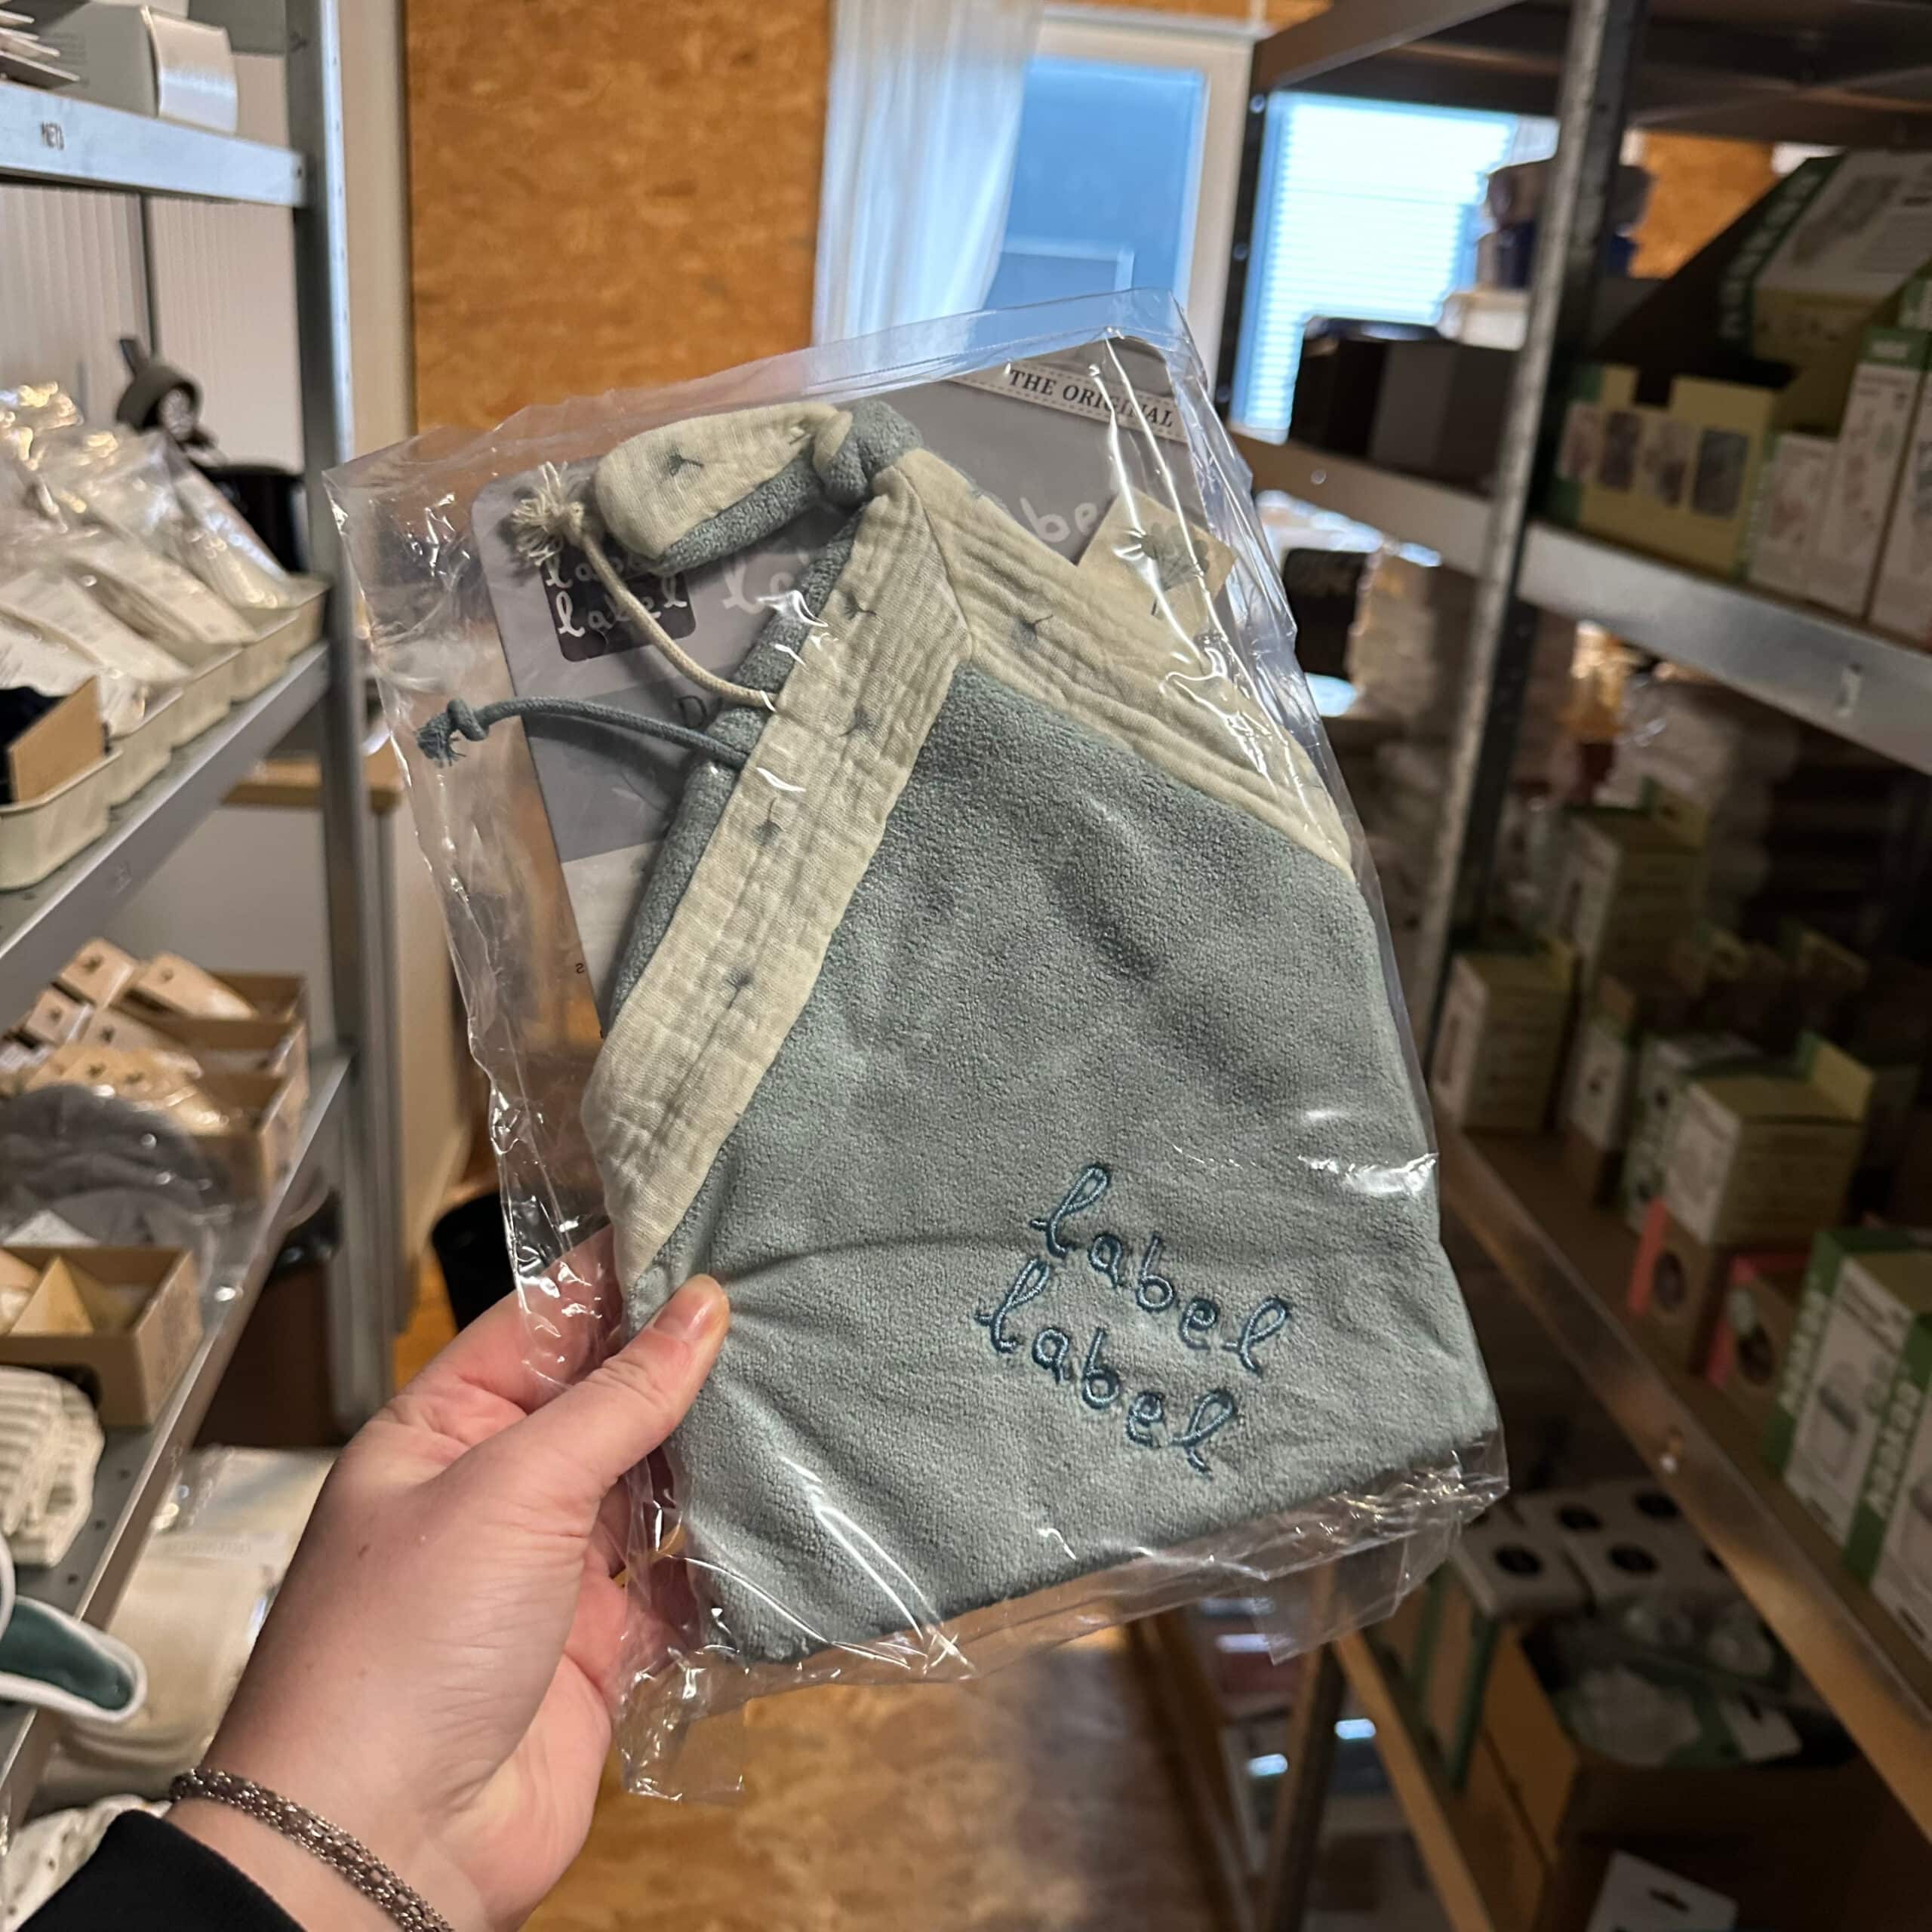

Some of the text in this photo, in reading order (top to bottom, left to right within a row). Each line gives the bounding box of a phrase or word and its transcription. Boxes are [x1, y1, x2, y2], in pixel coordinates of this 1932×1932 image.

[1009, 369, 1174, 428] THE ORIGINAL
[974, 1256, 1238, 1477] label
[1029, 1162, 1291, 1377] label
